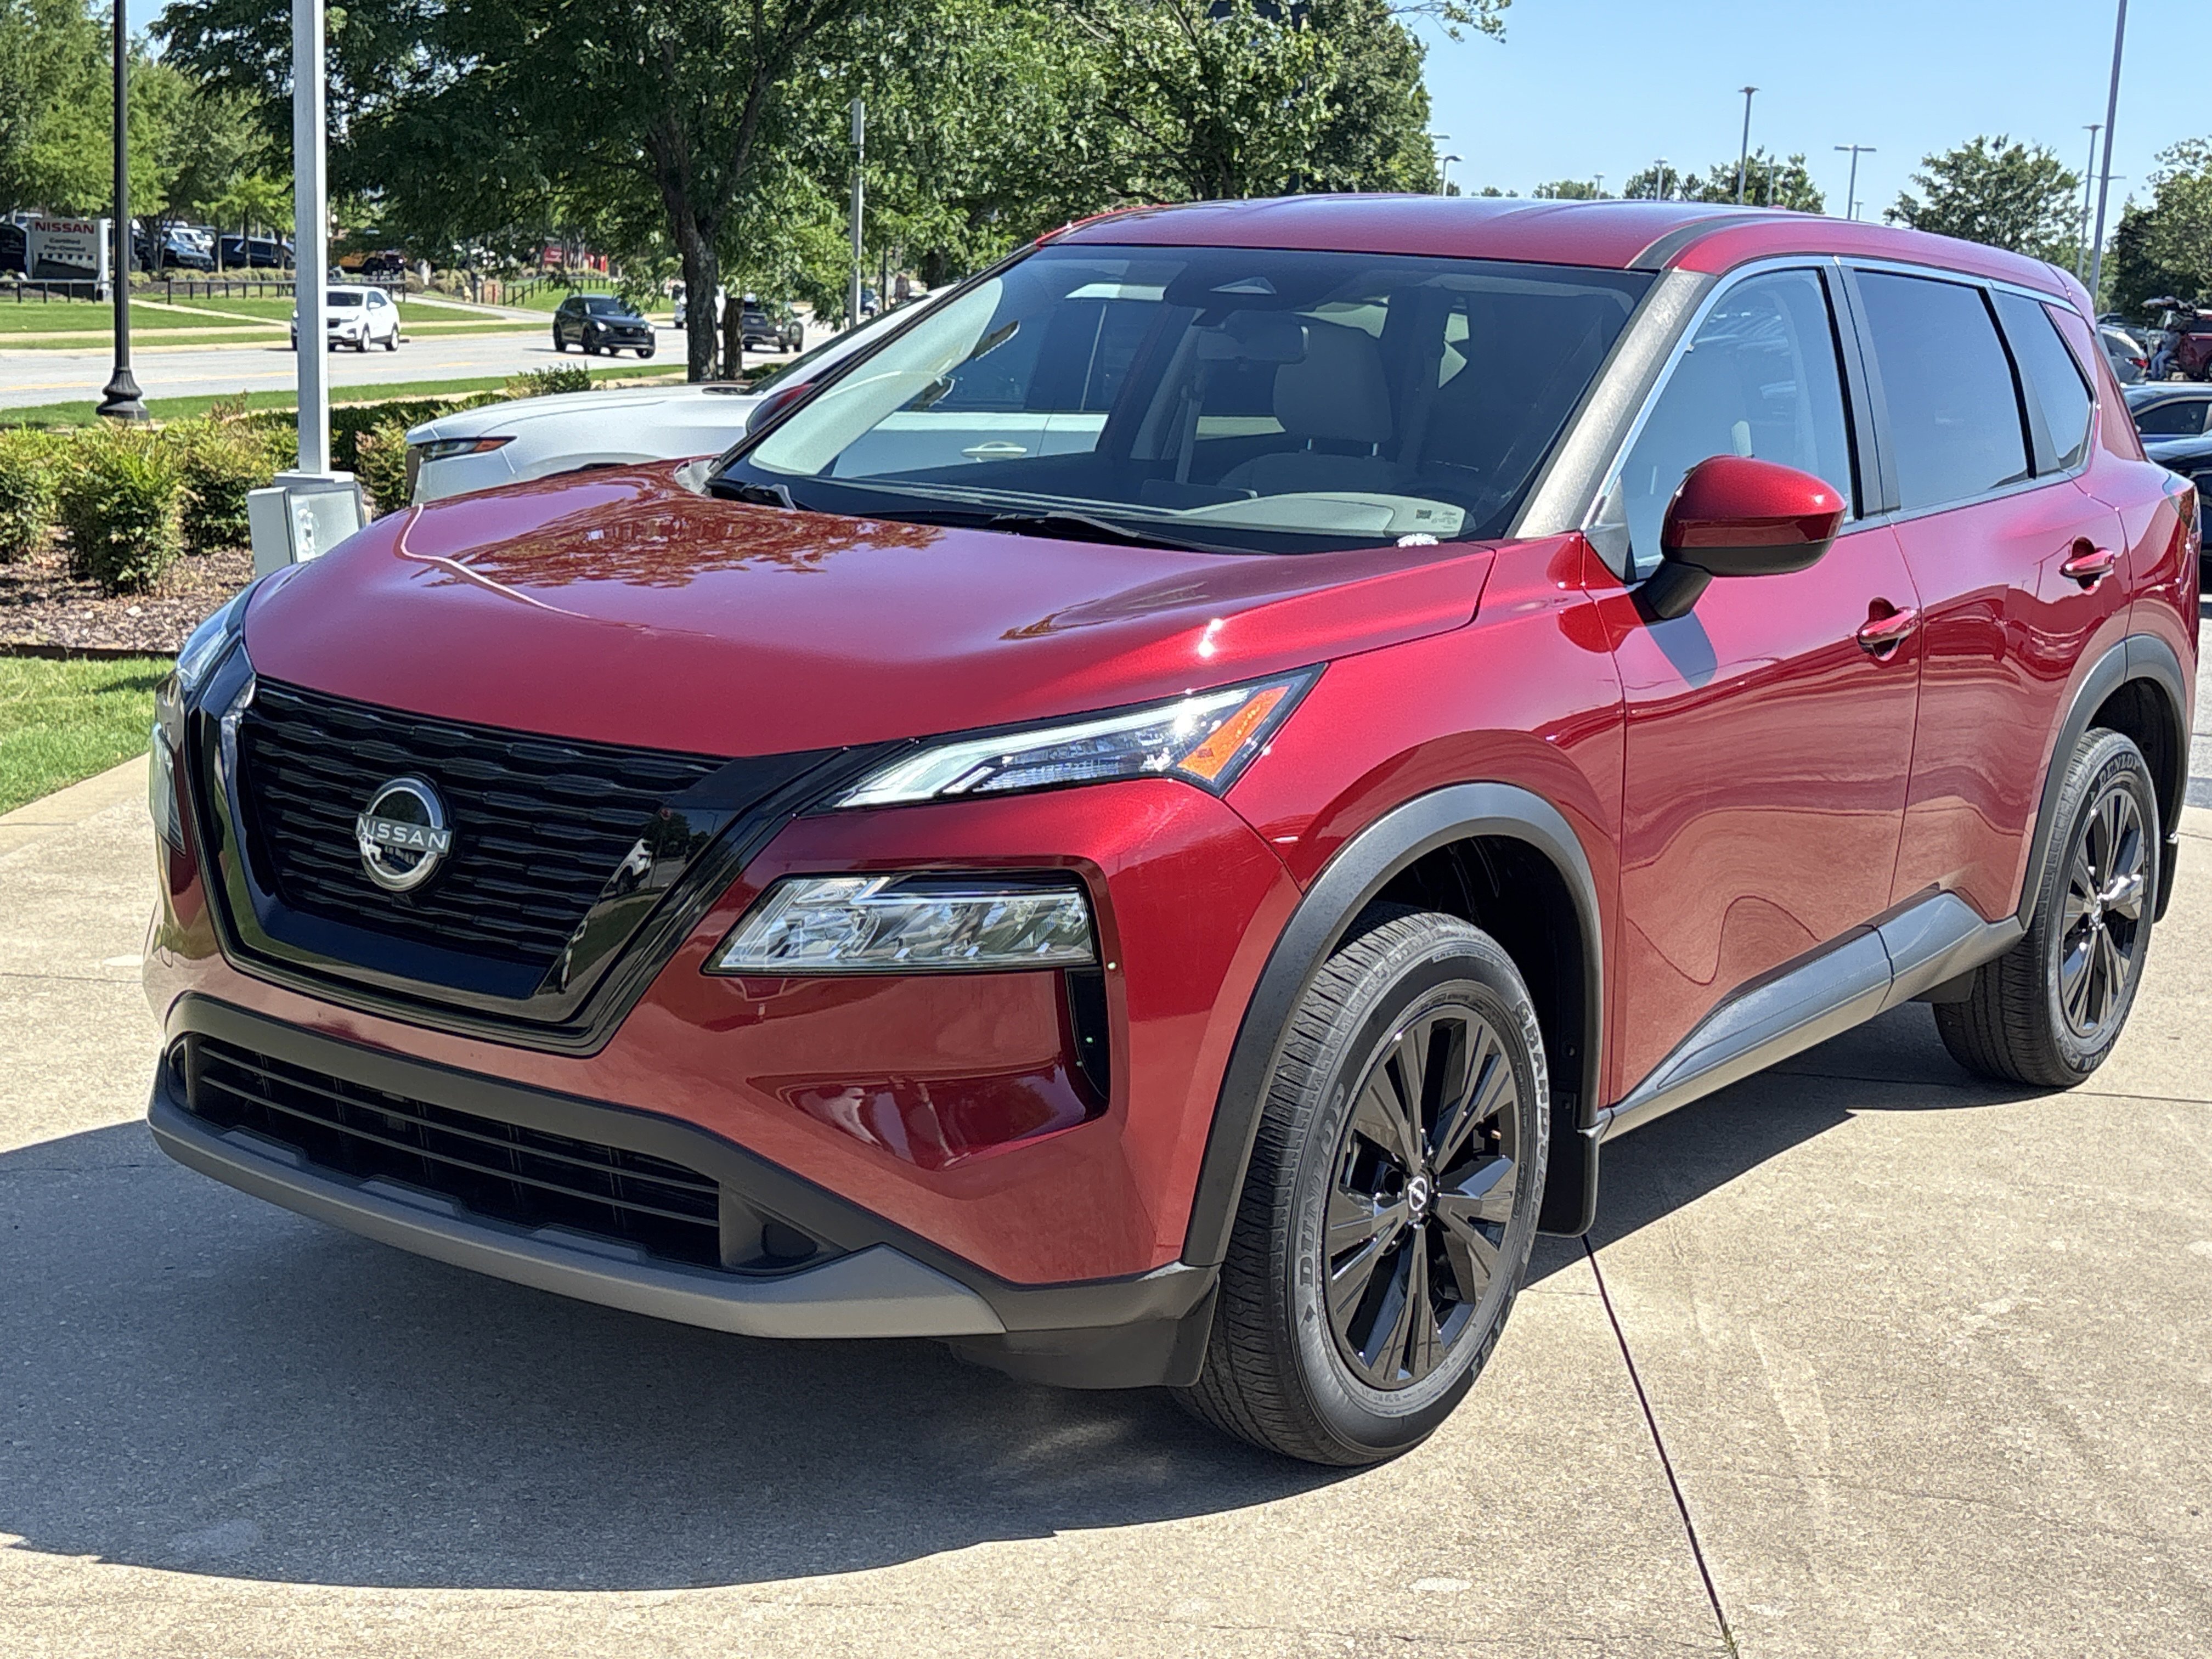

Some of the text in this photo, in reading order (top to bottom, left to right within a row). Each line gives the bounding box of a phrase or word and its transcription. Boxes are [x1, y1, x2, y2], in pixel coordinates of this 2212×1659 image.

[35, 222, 94, 234] NISSAN
[358, 817, 447, 849] NISSAN
[1300, 1082, 1345, 1288] DUNLOP
